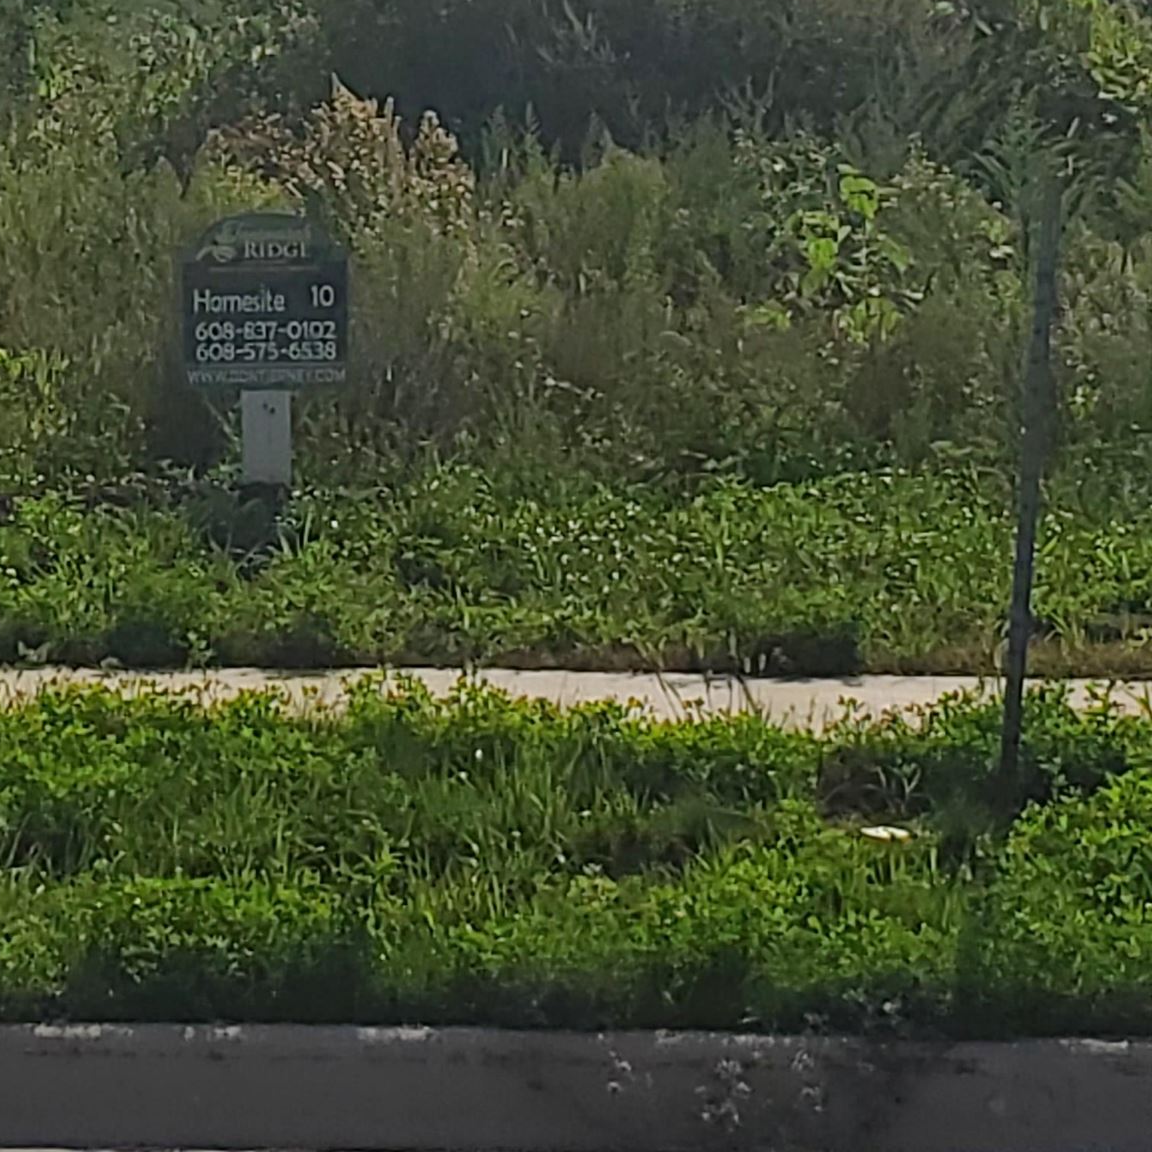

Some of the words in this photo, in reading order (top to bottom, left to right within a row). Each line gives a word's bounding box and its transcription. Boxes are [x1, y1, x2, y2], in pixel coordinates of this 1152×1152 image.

[193, 286, 285, 313] Homesite
[311, 285, 335, 307] 10
[195, 321, 337, 341] 608-837-0102
[196, 341, 337, 361] 608-575-6538
